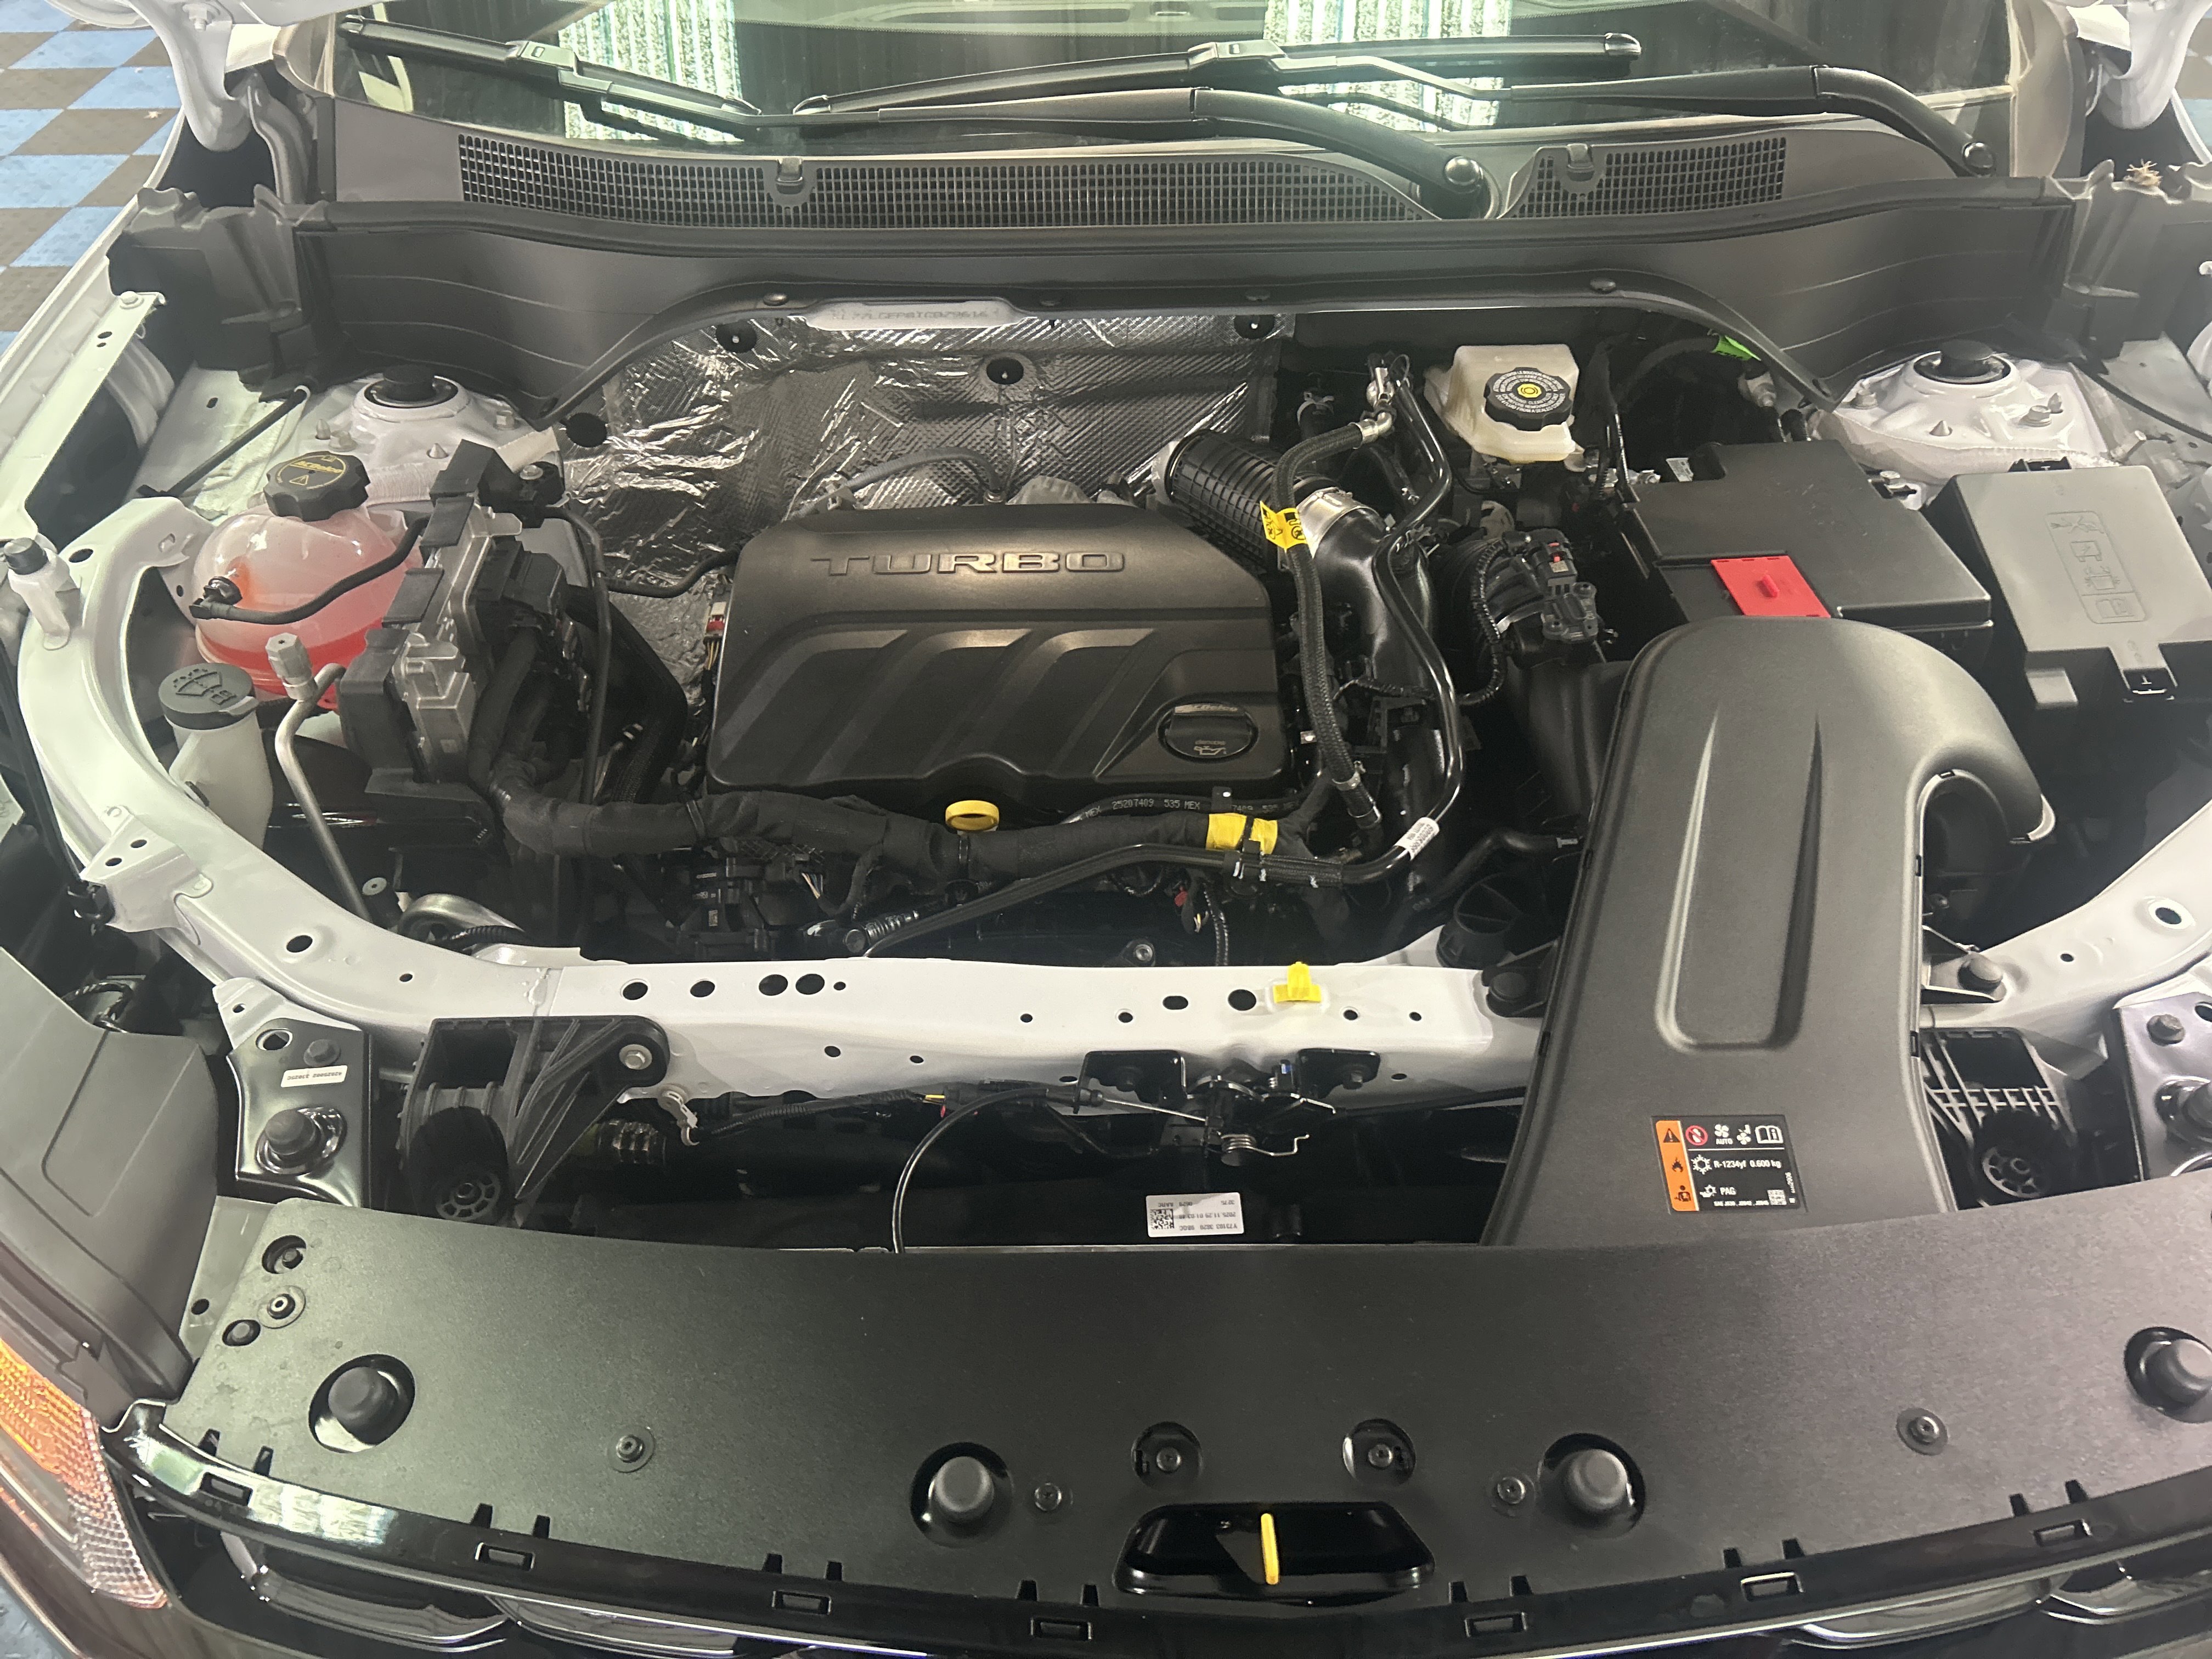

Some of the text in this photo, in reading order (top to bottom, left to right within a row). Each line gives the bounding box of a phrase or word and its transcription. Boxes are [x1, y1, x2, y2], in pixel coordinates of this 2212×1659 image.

[810, 551, 1125, 577] TURBO
[1111, 798, 1200, 810] 25207409 535 MEX
[1713, 1160, 1747, 1169] R-1234yf
[1771, 1159, 1782, 1169] kg
[1719, 1187, 1737, 1195] PAG
